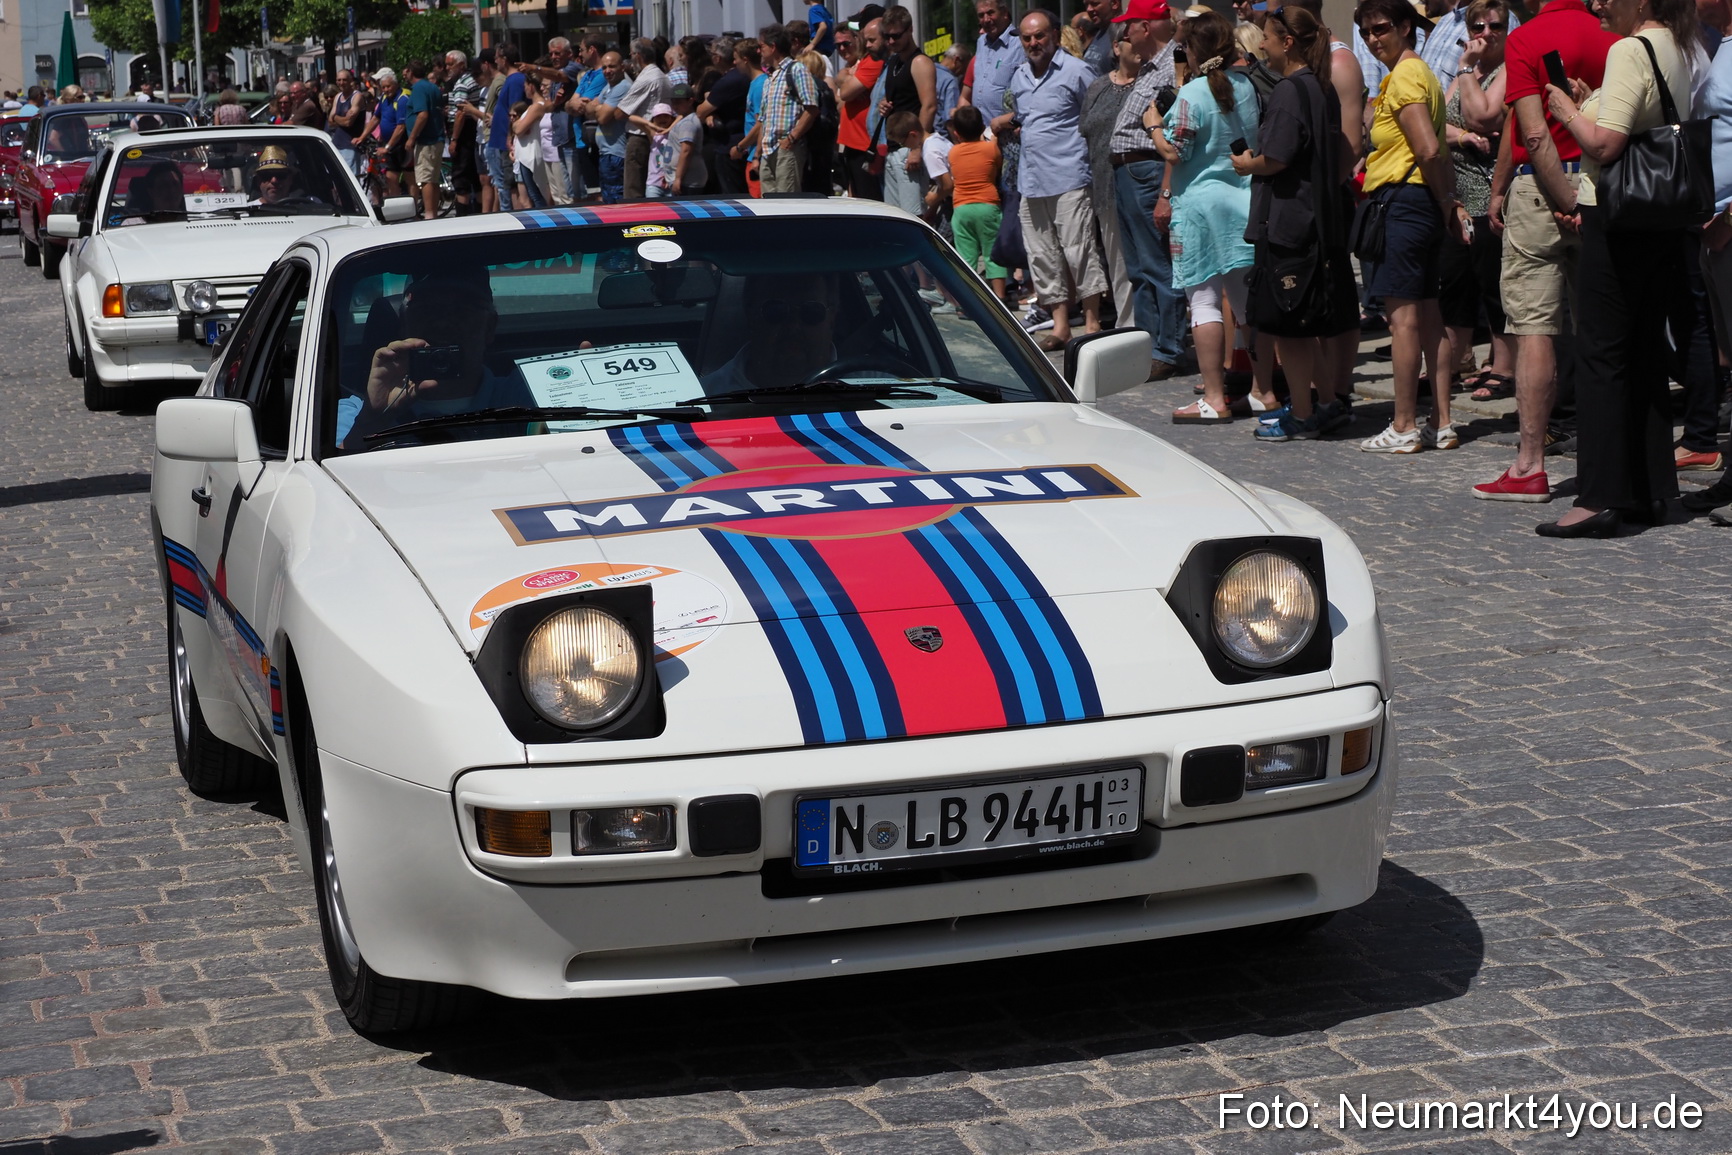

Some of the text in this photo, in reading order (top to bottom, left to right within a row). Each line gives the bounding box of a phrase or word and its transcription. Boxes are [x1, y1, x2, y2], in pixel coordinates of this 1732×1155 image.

[604, 357, 657, 376] 549
[543, 471, 1088, 532] MARTINI
[1107, 778, 1129, 793] 03
[834, 804, 865, 856] N
[906, 797, 968, 850] LB
[982, 781, 1104, 843] 944H
[1107, 813, 1127, 827] 10
[807, 839, 819, 854] D
[1038, 839, 1105, 854] www.blach.de
